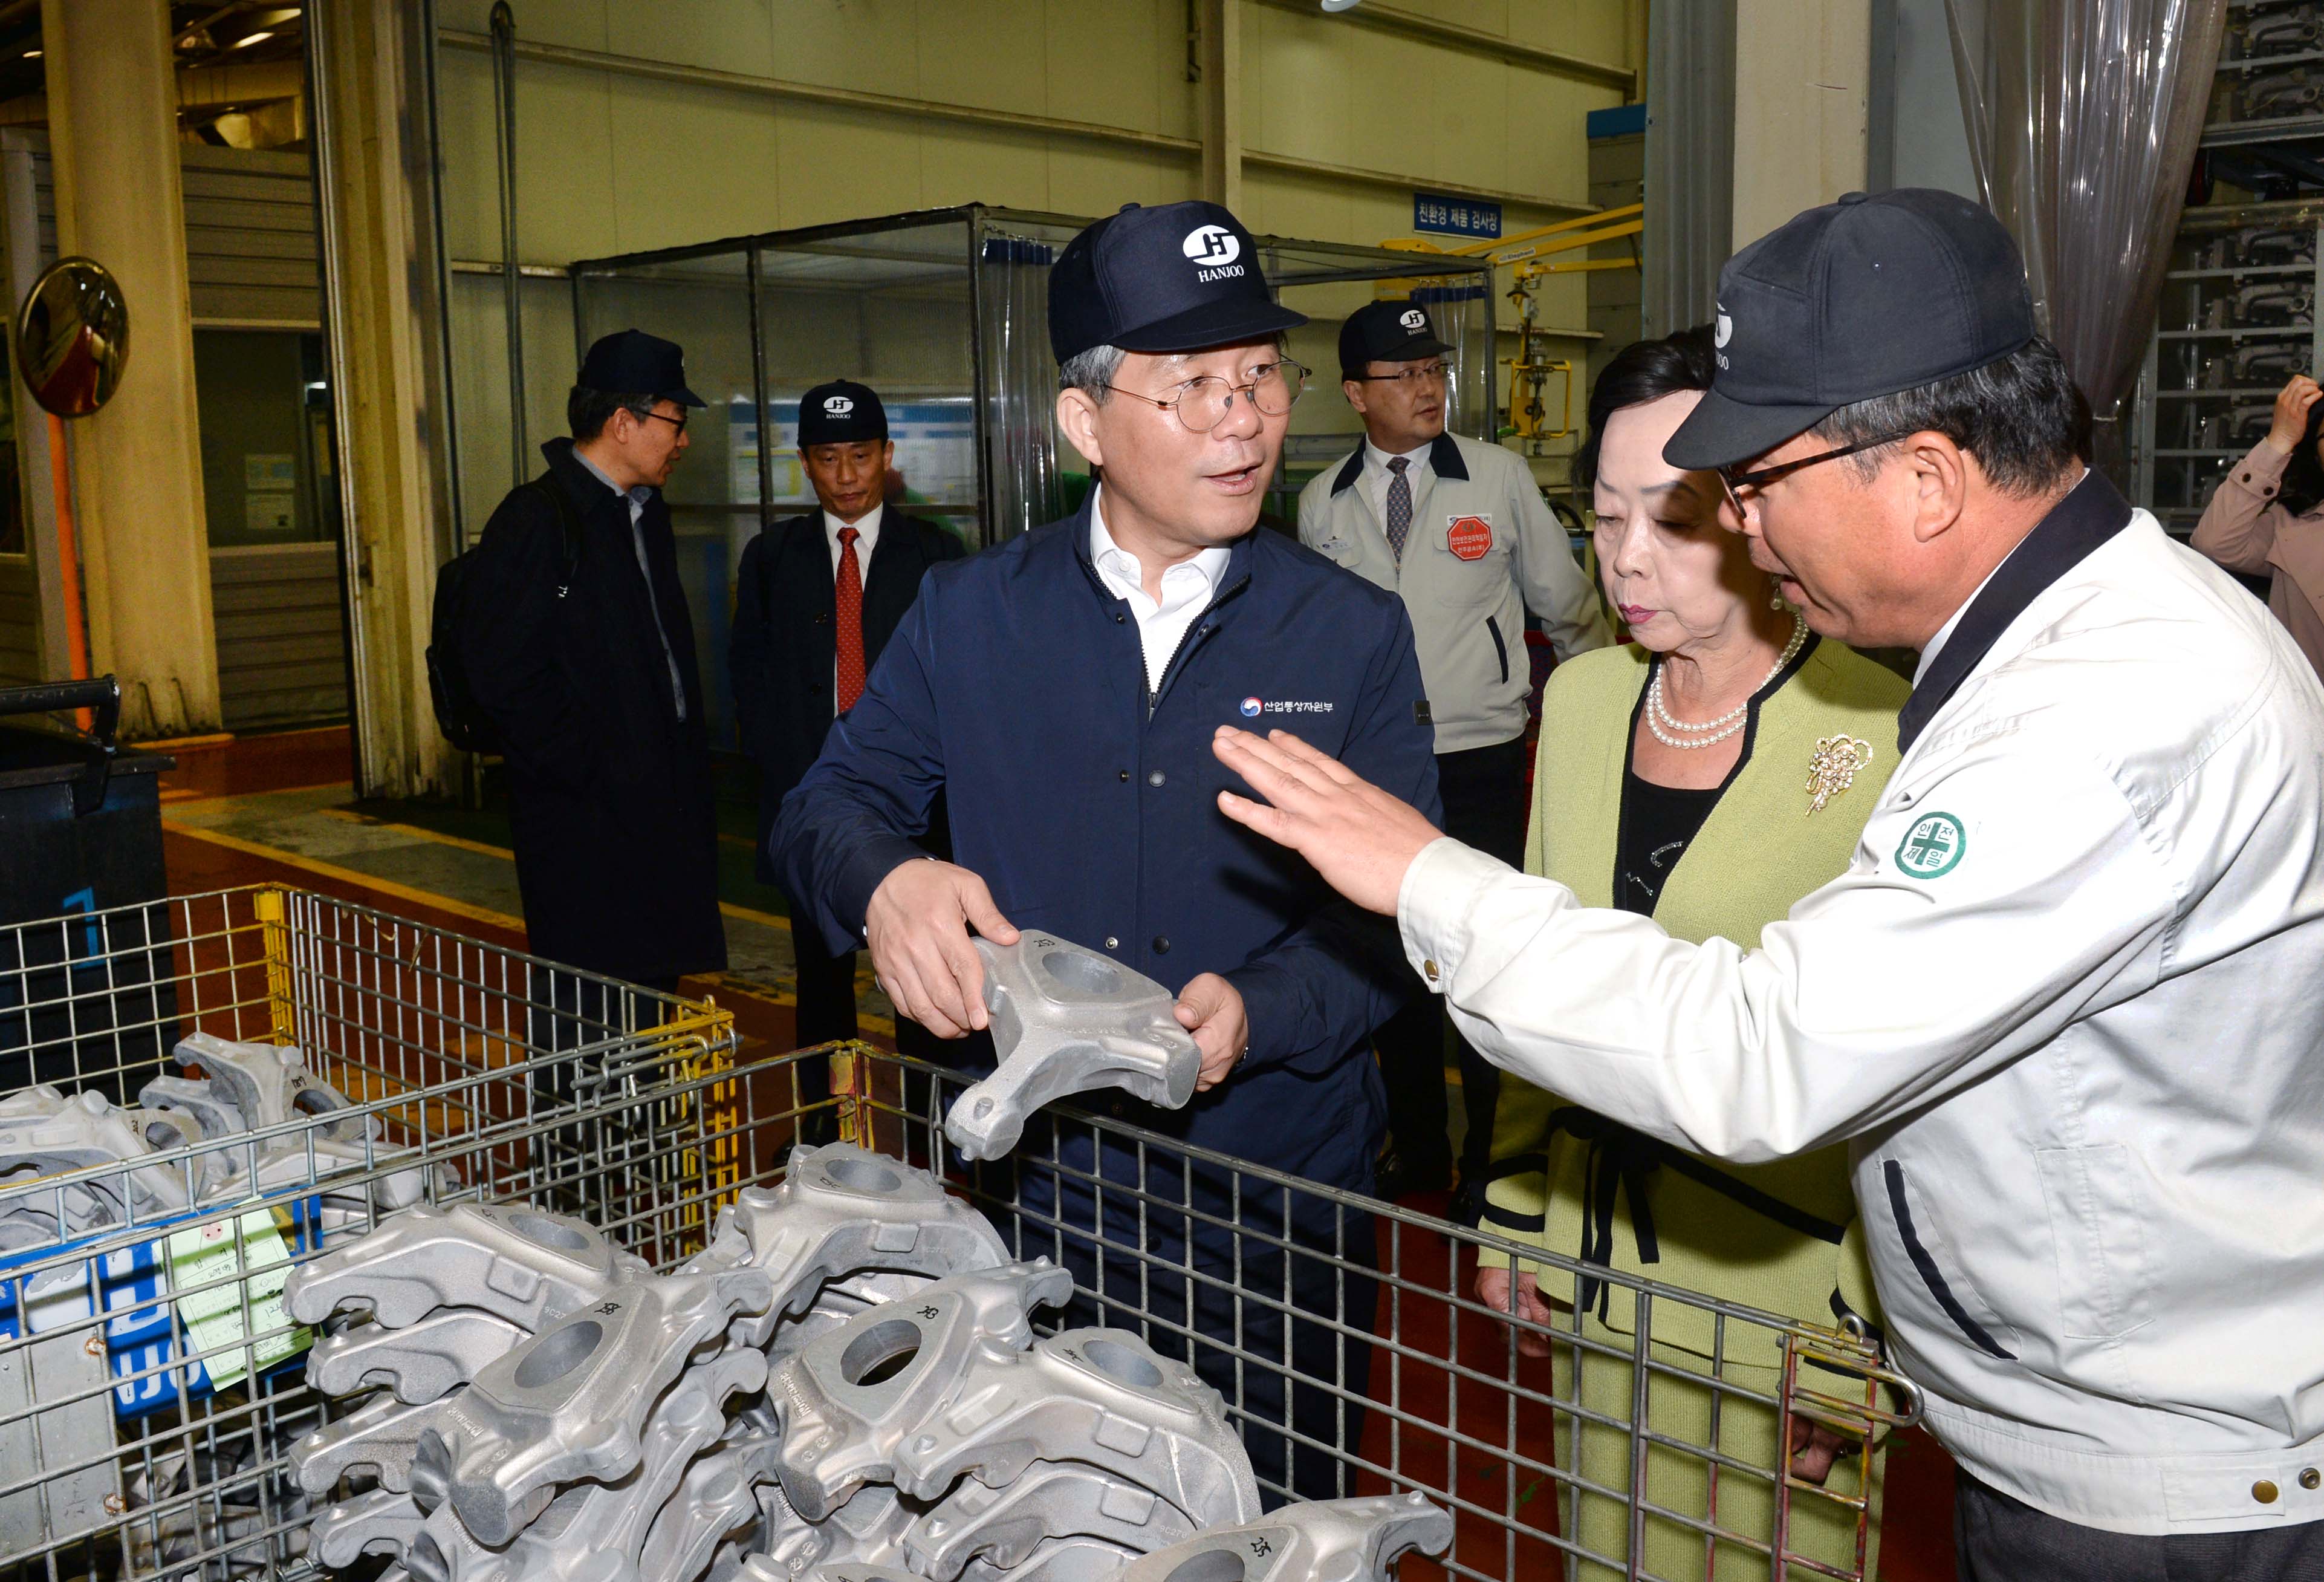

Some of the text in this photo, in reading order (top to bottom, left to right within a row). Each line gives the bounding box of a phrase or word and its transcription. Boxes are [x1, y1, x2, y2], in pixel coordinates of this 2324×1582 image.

[1419, 203, 1498, 232] 친환경 제품 검사장
[1198, 265, 1244, 282] HANJOO
[1264, 701, 1333, 712] 산업통상자원부
[1918, 823, 1954, 841] 안전
[1903, 847, 1943, 867] 제일
